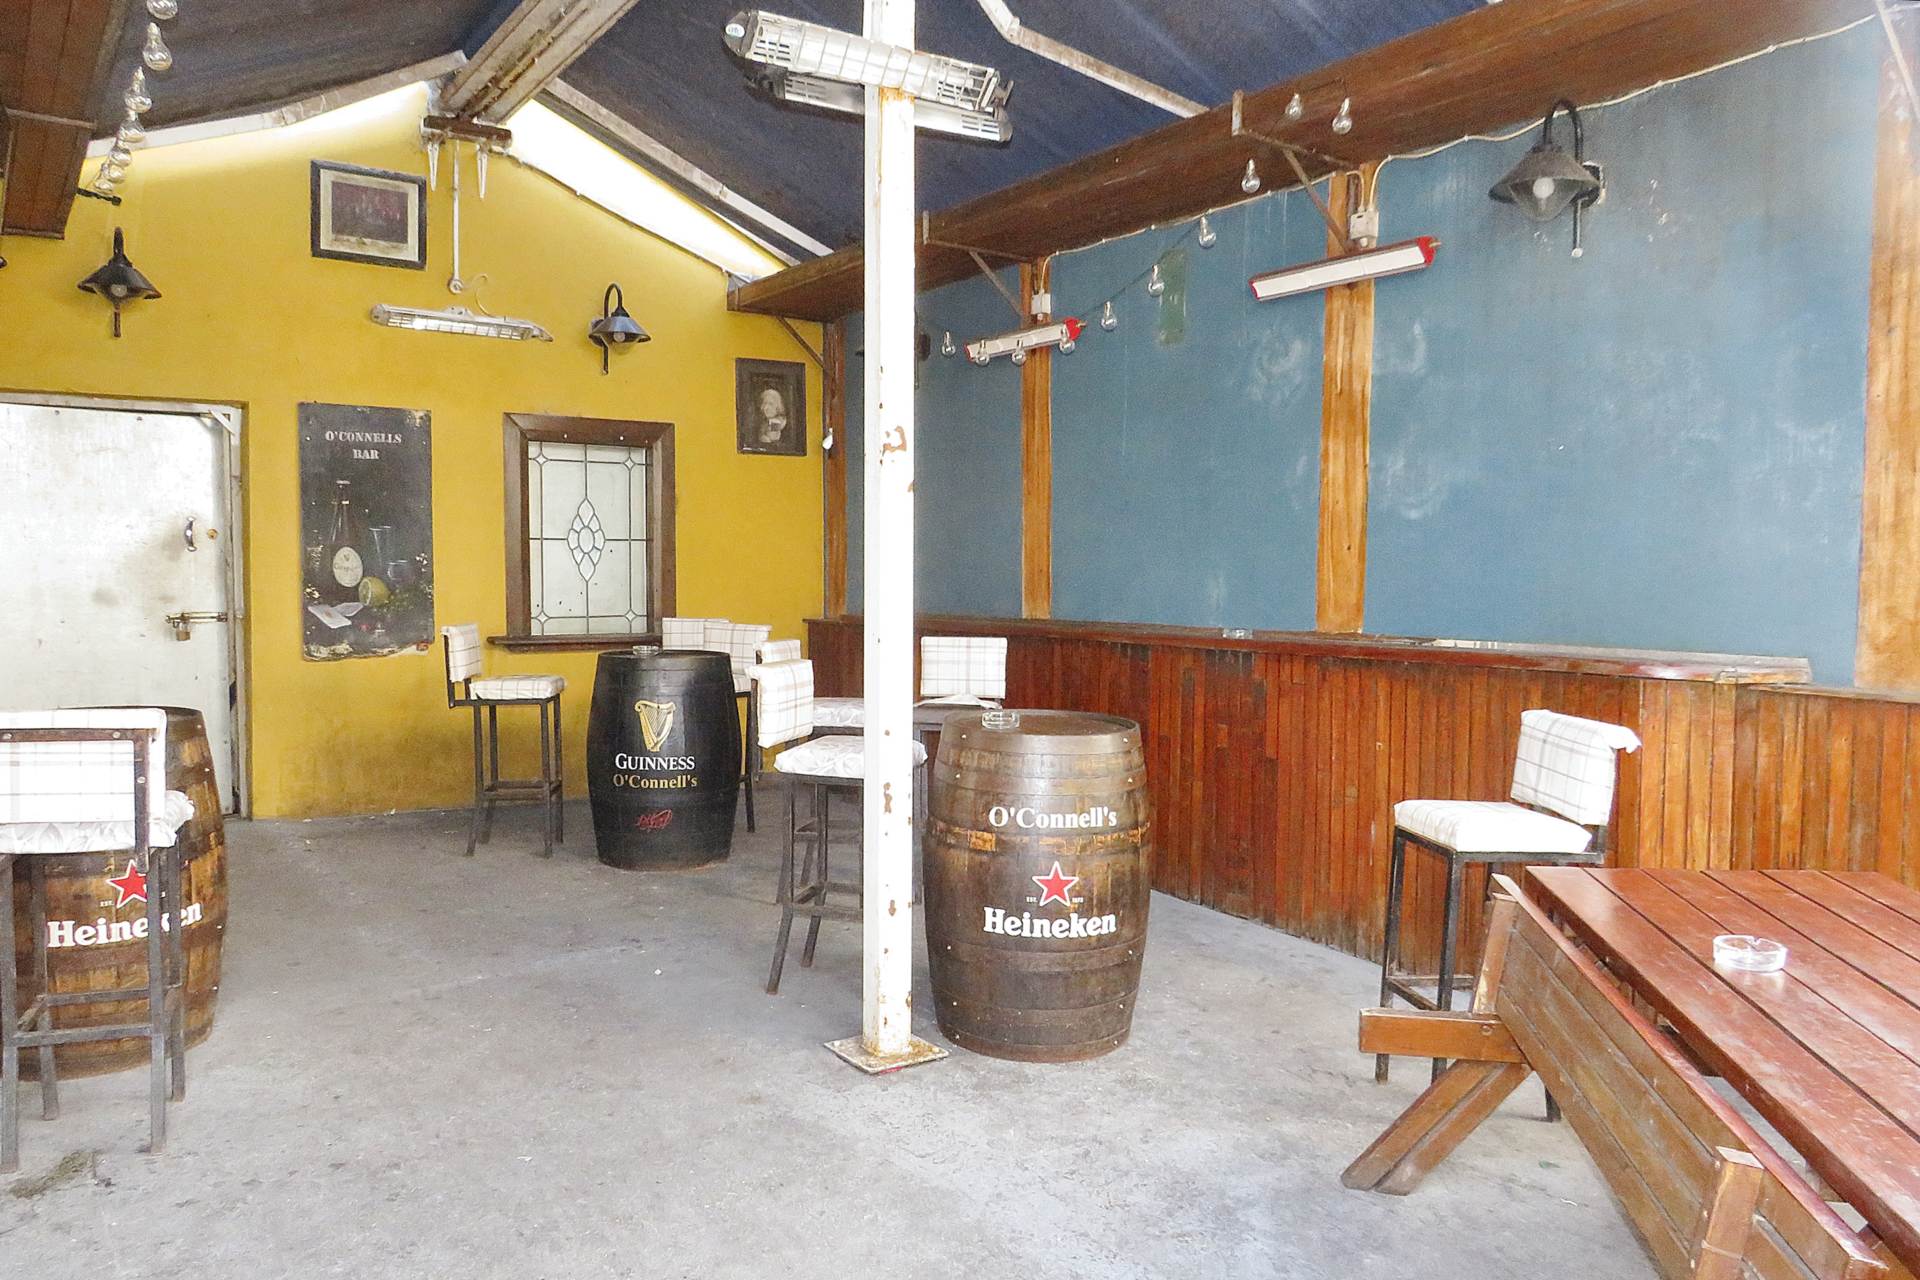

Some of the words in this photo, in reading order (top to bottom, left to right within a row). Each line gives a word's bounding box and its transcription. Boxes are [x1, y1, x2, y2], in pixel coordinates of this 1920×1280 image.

[325, 430, 402, 444] O'CONNELLS
[352, 449, 379, 459] BAR
[613, 774, 697, 789] O'Connell's
[988, 806, 1117, 828] O'Connell's
[983, 907, 1116, 938] Heineken
